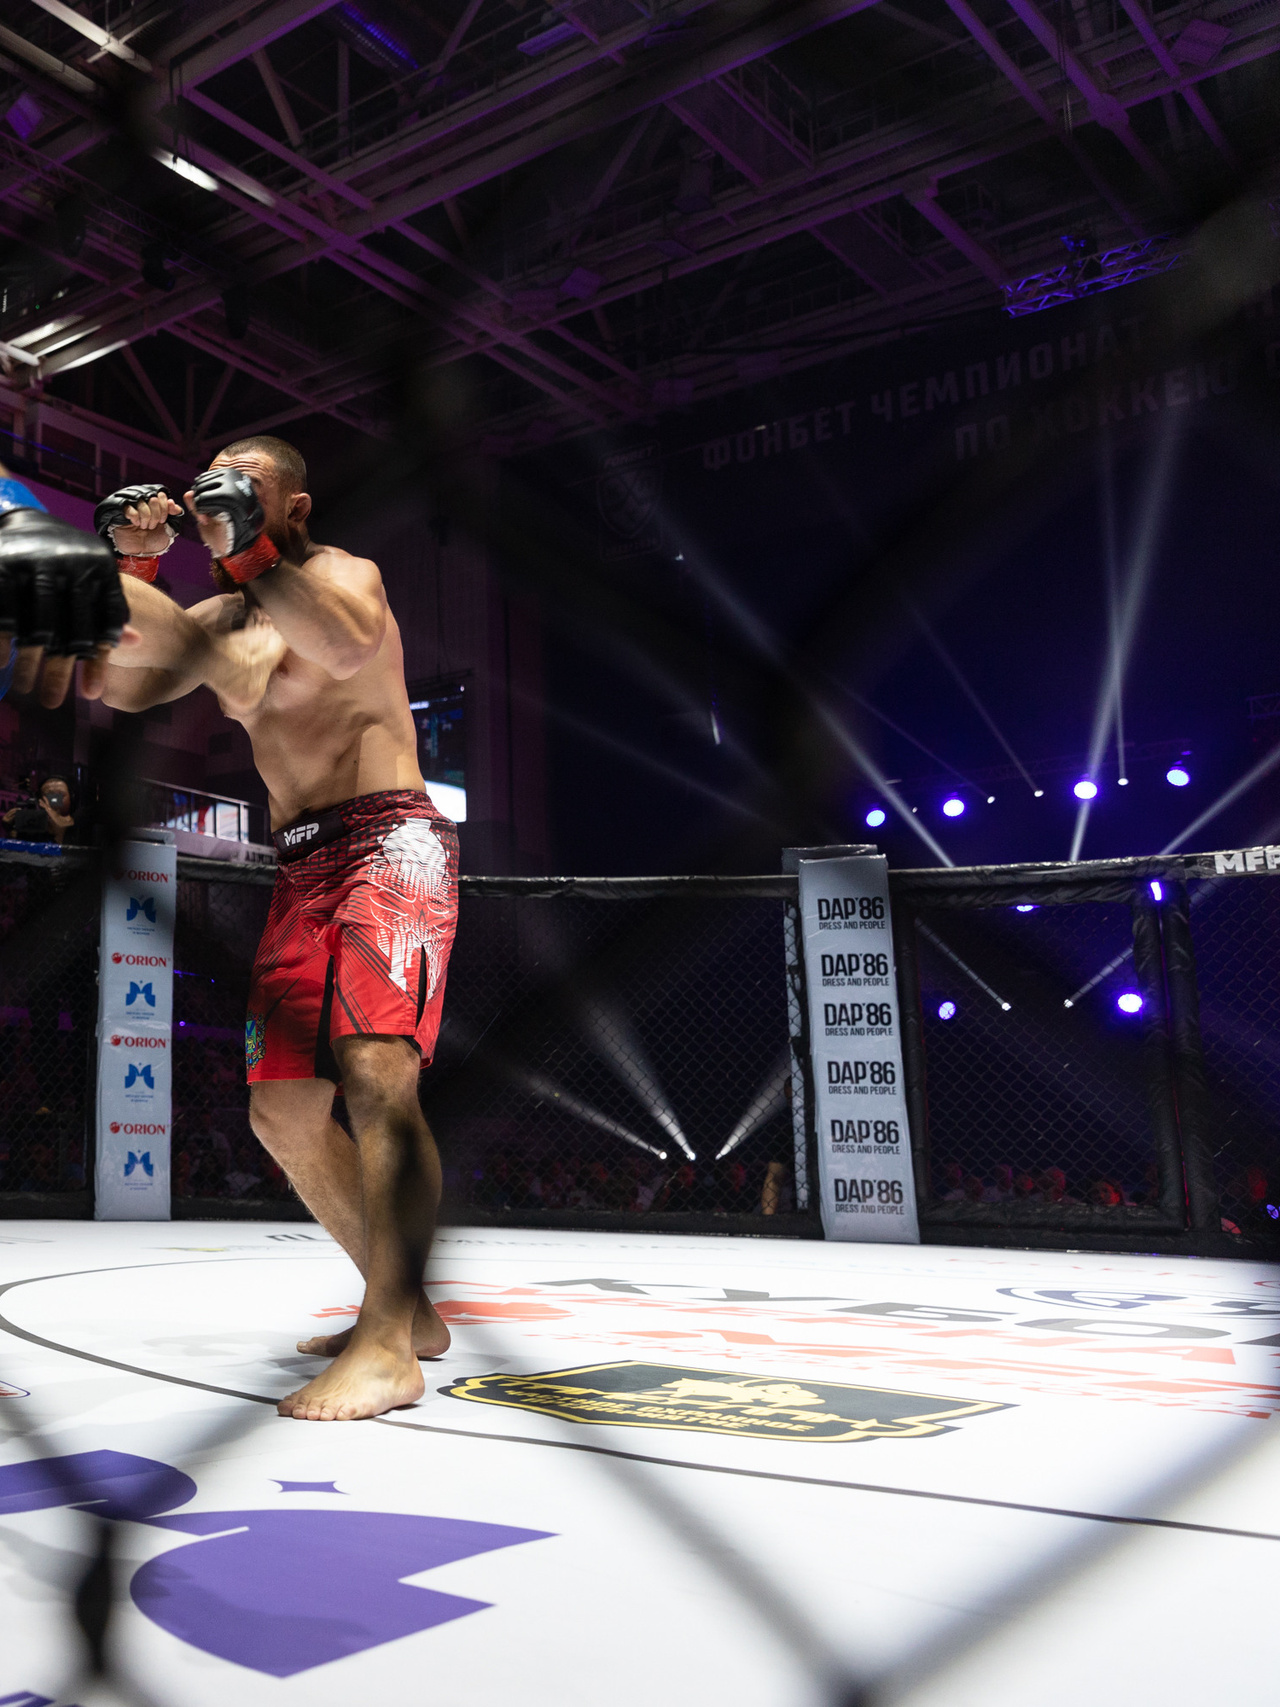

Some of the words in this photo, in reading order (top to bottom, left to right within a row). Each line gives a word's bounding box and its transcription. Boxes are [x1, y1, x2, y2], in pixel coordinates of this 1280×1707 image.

[703, 402, 855, 471] ФОНБЕТ
[127, 869, 169, 883] ORION
[819, 921, 842, 930] DRESS
[843, 921, 858, 930] AND
[859, 920, 886, 930] PEOPLE
[125, 954, 167, 968] ORION
[822, 977, 846, 987] DRESS
[847, 977, 862, 987] AND
[863, 977, 890, 987] PEOPLE
[825, 1027, 849, 1037] DRESS
[850, 1027, 865, 1037] AND
[866, 1027, 893, 1037] PEOPLE
[124, 1035, 167, 1049] ORION
[828, 1085, 852, 1095] DRESS
[853, 1085, 869, 1095] AND
[870, 1085, 897, 1096] PEOPLE
[123, 1122, 166, 1136] ORION
[832, 1144, 856, 1154] DRESS
[856, 1145, 872, 1154] AND
[873, 1145, 901, 1155] PEOPLE
[835, 1204, 859, 1214] DRESS
[860, 1204, 876, 1214] AND
[877, 1204, 905, 1216] PEOPLE
[529, 1278, 1280, 1347] КУБО
[423, 1280, 1280, 1368] ГУБЕРНА
[636, 1406, 816, 1432] ОХРАННОЕ
